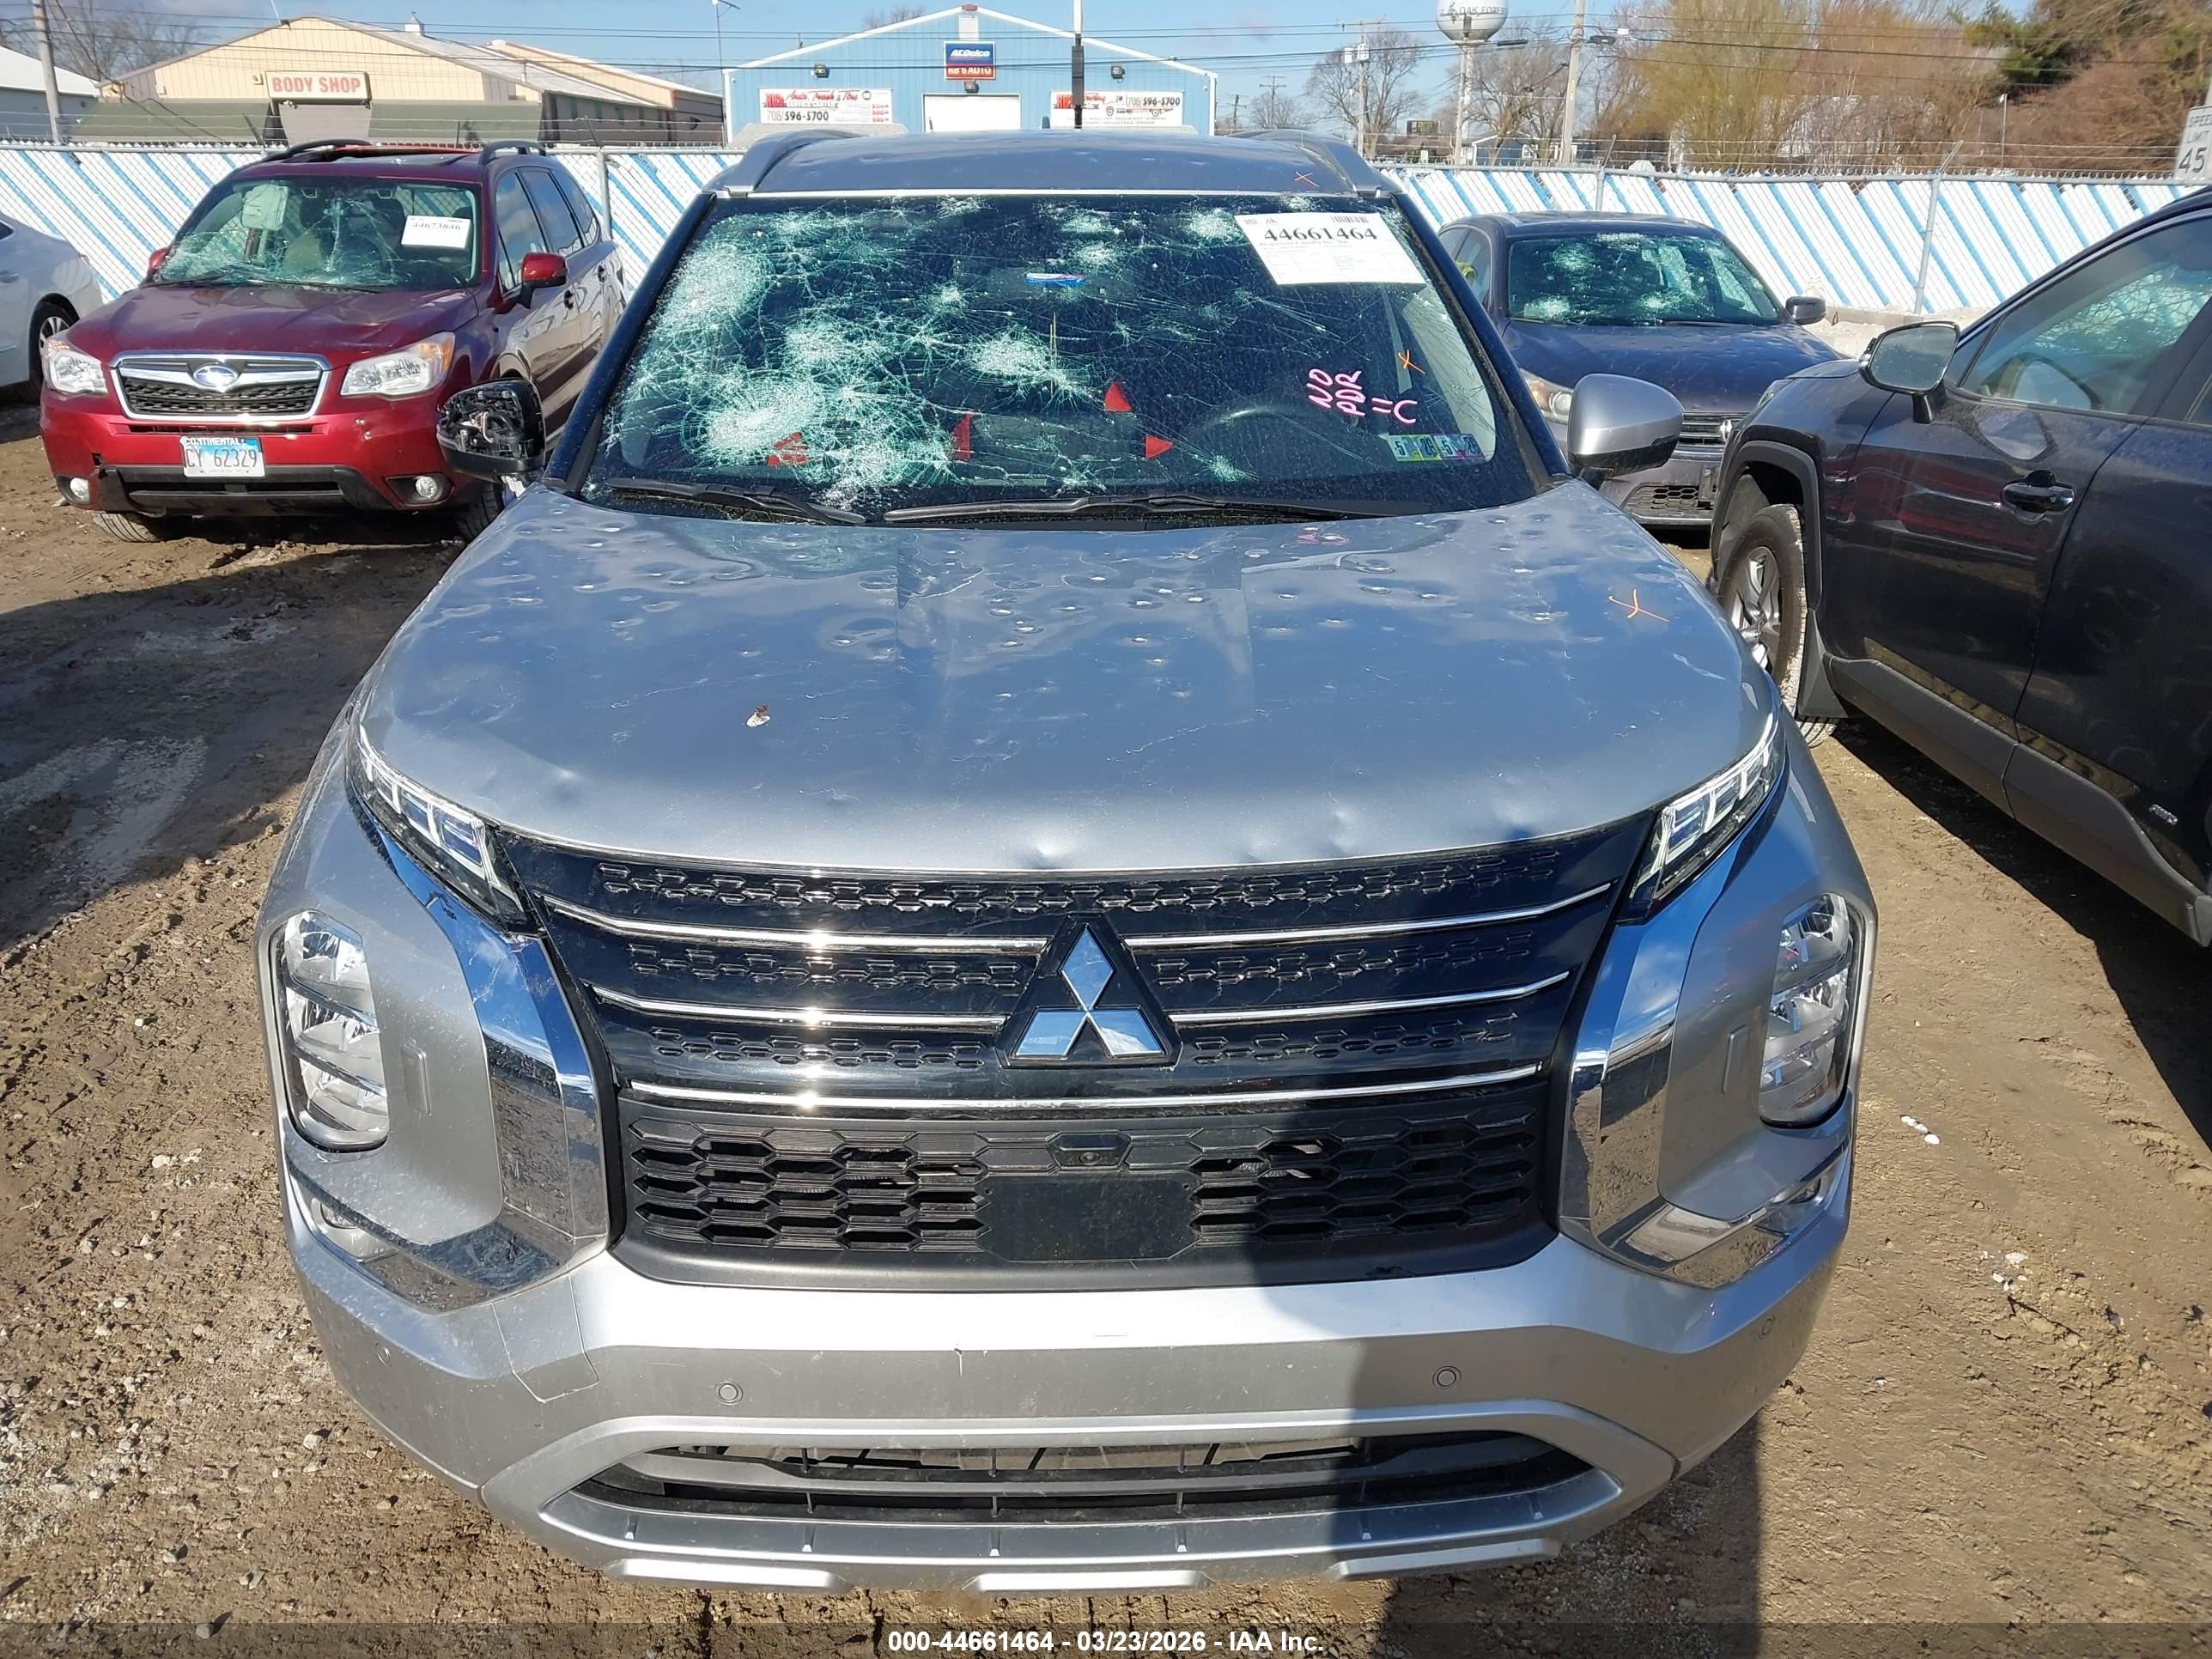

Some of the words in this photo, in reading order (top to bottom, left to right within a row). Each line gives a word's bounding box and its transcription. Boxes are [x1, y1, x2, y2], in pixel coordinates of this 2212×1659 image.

[1460, 6, 1478, 15] OAK
[272, 76, 313, 92] BODY
[319, 76, 361, 93] SHOP
[2179, 147, 2208, 173] 45
[1264, 227, 1377, 241] 44661464
[185, 437, 240, 446] CONTINENTAL
[185, 448, 203, 467] CY
[214, 448, 257, 467] 62329
